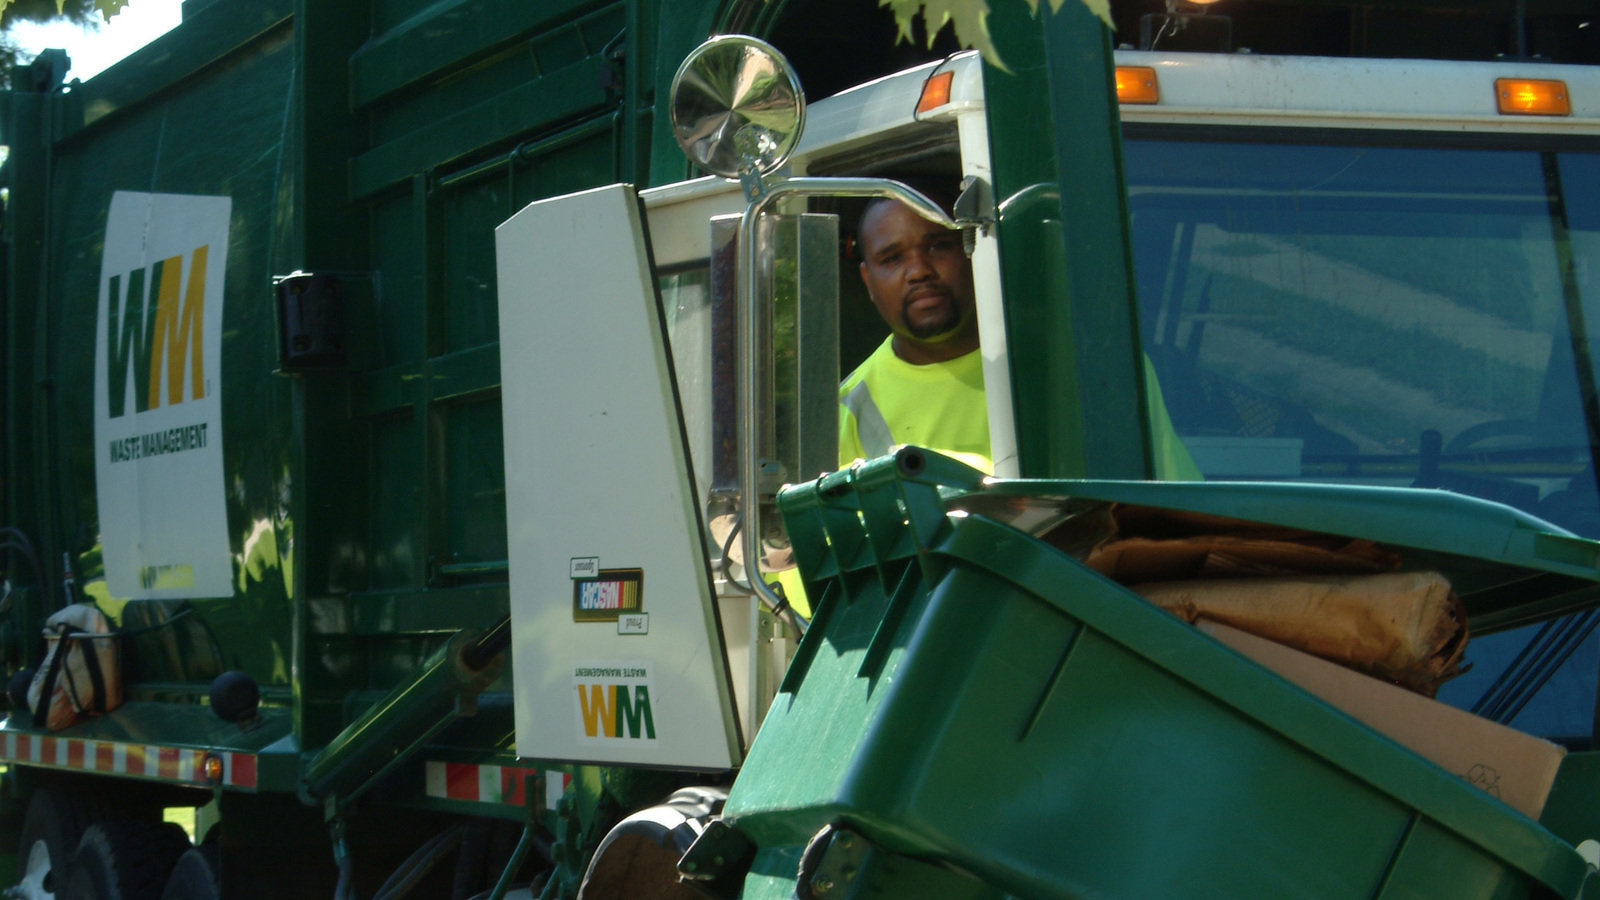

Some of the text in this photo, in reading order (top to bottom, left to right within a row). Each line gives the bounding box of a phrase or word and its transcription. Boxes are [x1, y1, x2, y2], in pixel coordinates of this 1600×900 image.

[108, 244, 208, 418] WM
[109, 422, 207, 463] WASTE MANAGEMENT
[582, 581, 620, 609] NASCAR
[575, 668, 647, 677] WASTE MANAGEMENT
[577, 684, 656, 739] WM
